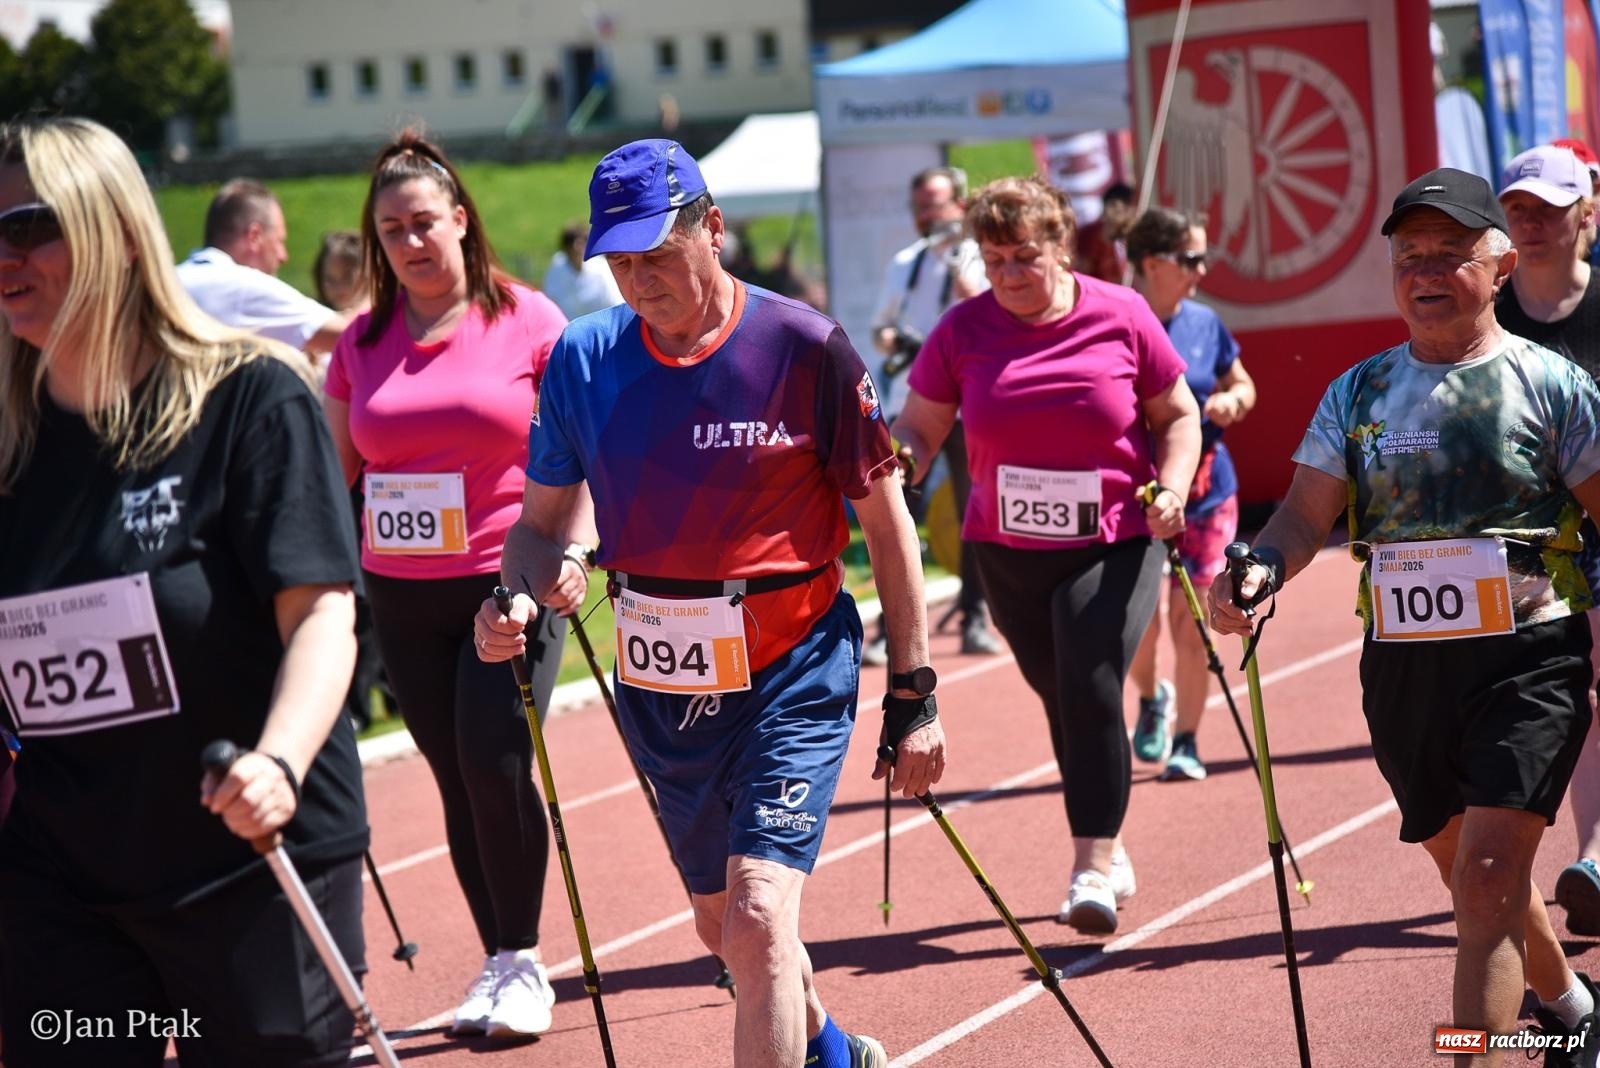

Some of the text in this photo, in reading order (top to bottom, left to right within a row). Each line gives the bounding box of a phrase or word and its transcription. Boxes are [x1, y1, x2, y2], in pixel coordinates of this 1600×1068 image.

[693, 421, 794, 449] ULTRA
[377, 510, 436, 540] 089
[1012, 499, 1070, 528] 253
[1379, 561, 1424, 573] 3MAJA2026
[1380, 545, 1472, 561] XVIII BIEG BEZ GRANIC
[620, 596, 709, 617] XVIII BIEG BEZ GRANIC
[621, 607, 661, 626] 3MAJA2026
[1391, 584, 1464, 623] 100
[627, 635, 709, 676] 094
[12, 648, 117, 709] 252
[766, 816, 812, 833] POLO CLUB
